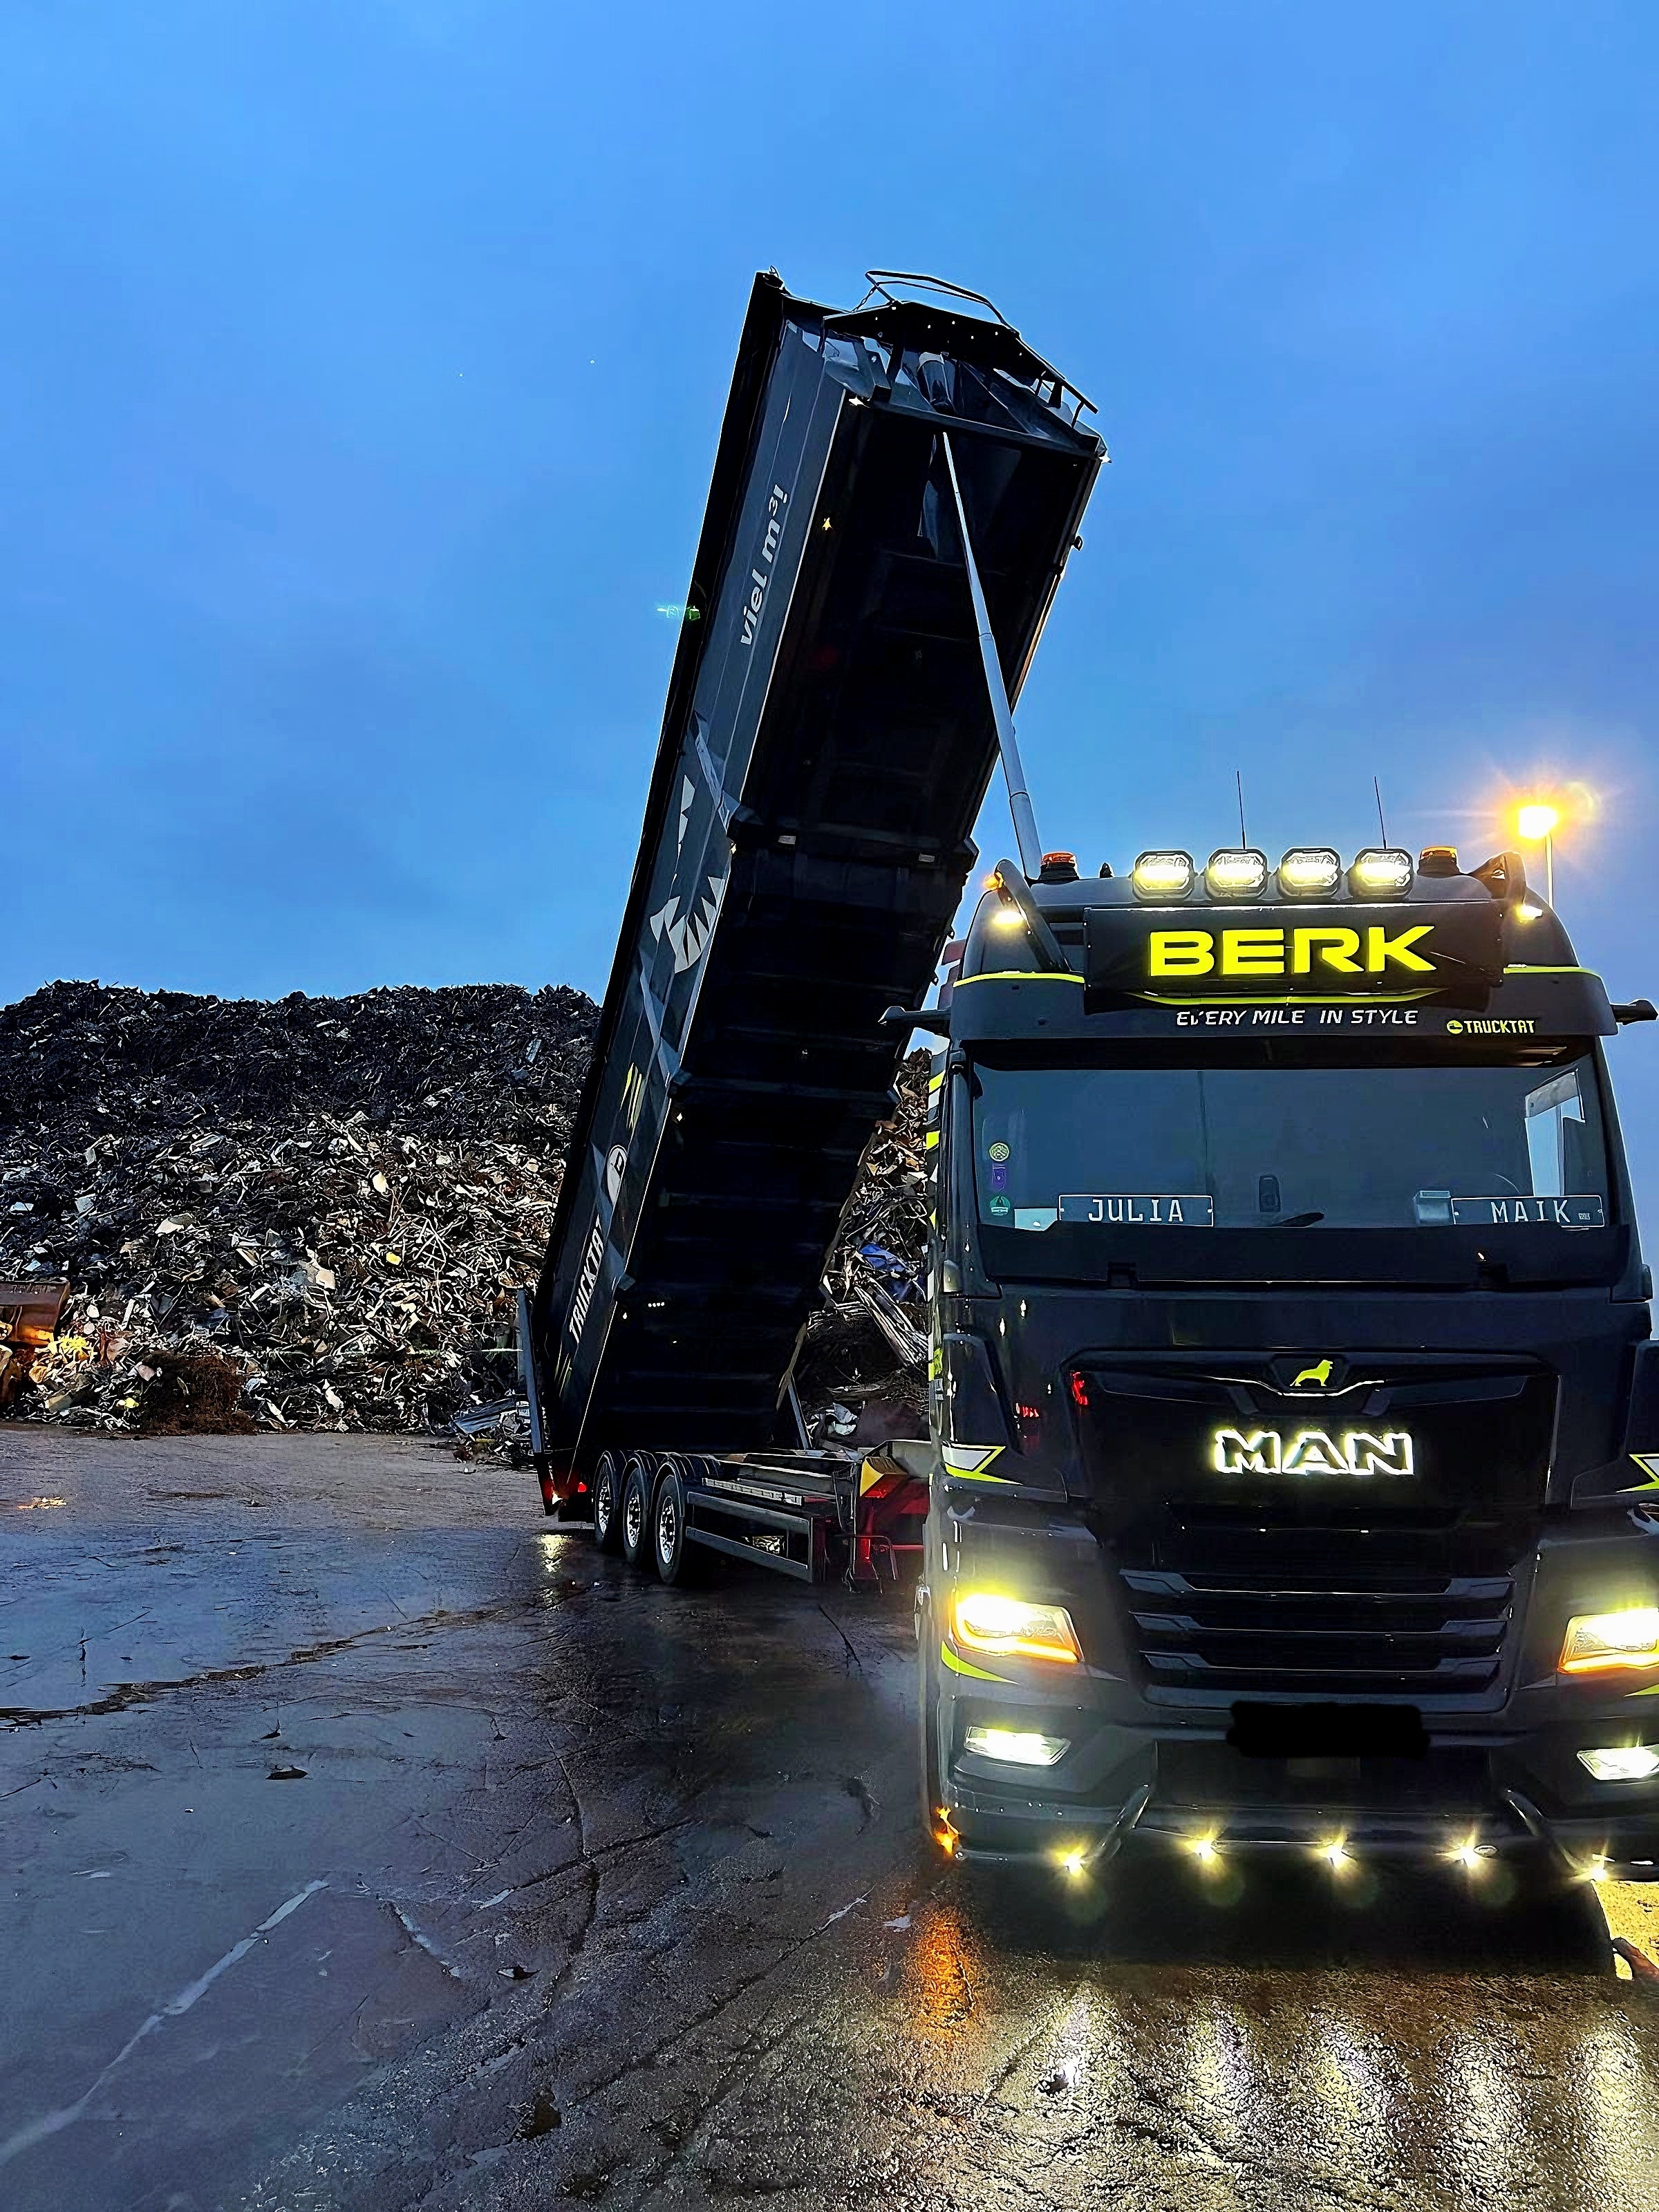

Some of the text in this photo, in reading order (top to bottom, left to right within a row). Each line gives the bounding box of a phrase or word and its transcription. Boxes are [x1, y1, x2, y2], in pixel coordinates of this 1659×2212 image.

[740, 568, 767, 646] viel
[1150, 926, 1437, 977] BERK
[1177, 1009, 1419, 1026] EVERY MILE IN STYLE
[1463, 1020, 1535, 1033] TRUCKTAT
[1088, 1199, 1184, 1222] JULIA
[1490, 1199, 1571, 1224] MAIK
[569, 1213, 604, 1343] TRUCKTAT
[1215, 1430, 1414, 1476] MAN
